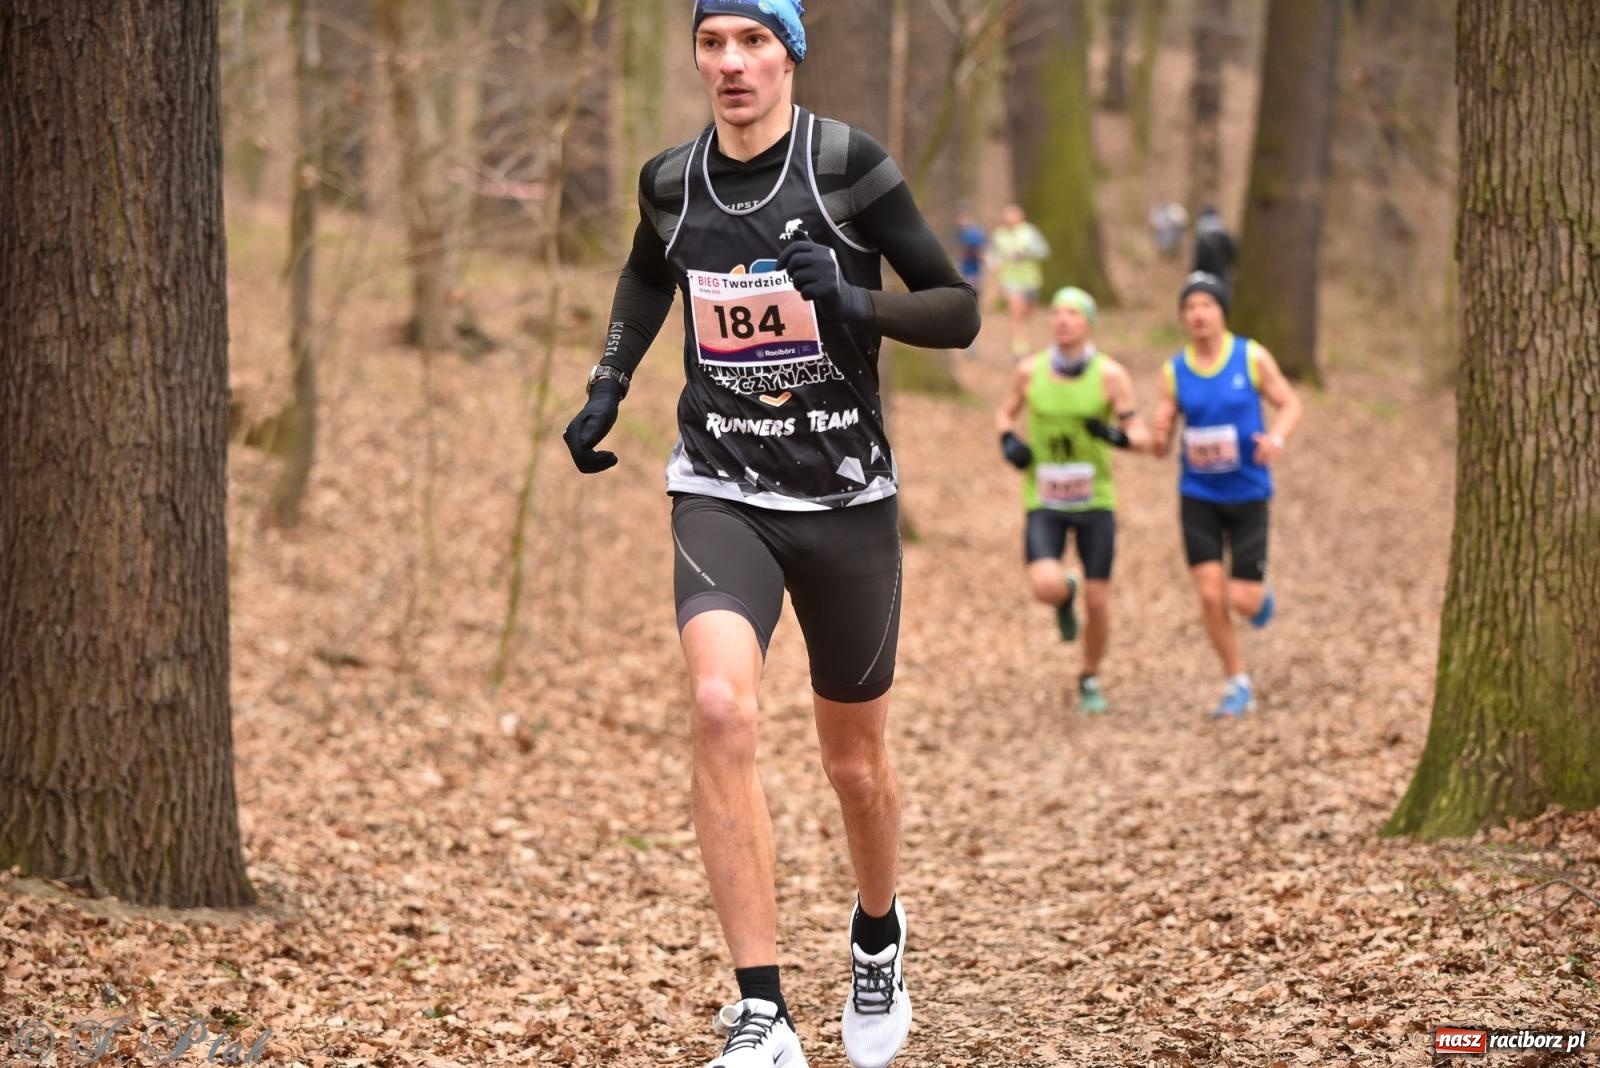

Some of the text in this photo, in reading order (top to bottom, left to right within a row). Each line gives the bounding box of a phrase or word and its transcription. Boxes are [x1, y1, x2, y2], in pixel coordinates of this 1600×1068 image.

[698, 275, 720, 288] BIEG
[604, 321, 624, 356] KIPSTA
[713, 304, 786, 340] 184
[764, 347, 796, 357] Racibórz
[706, 407, 859, 440] RUNNERS TEAM
